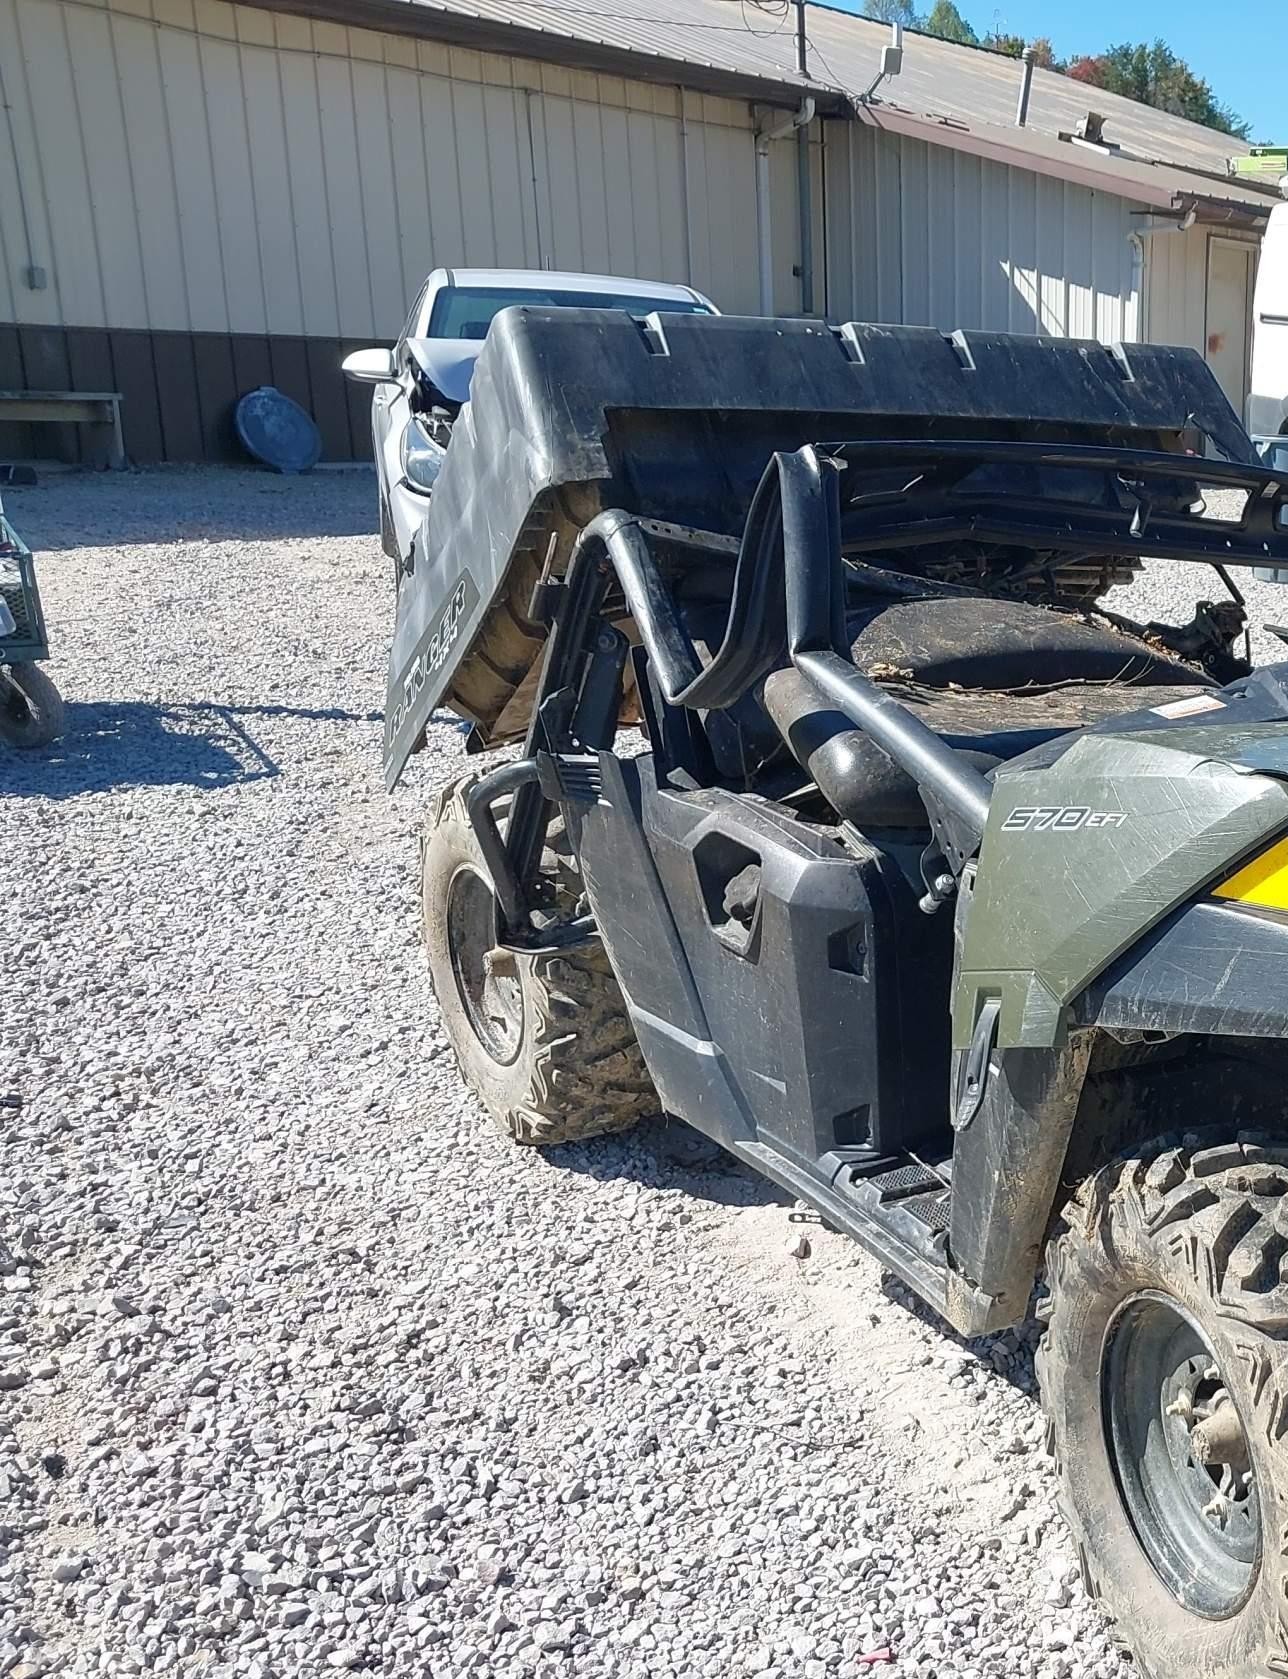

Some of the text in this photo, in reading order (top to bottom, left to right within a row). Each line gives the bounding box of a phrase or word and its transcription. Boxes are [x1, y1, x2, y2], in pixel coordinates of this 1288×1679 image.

[389, 579, 466, 748] RANGER
[1001, 806, 1129, 832] 570 EFI
